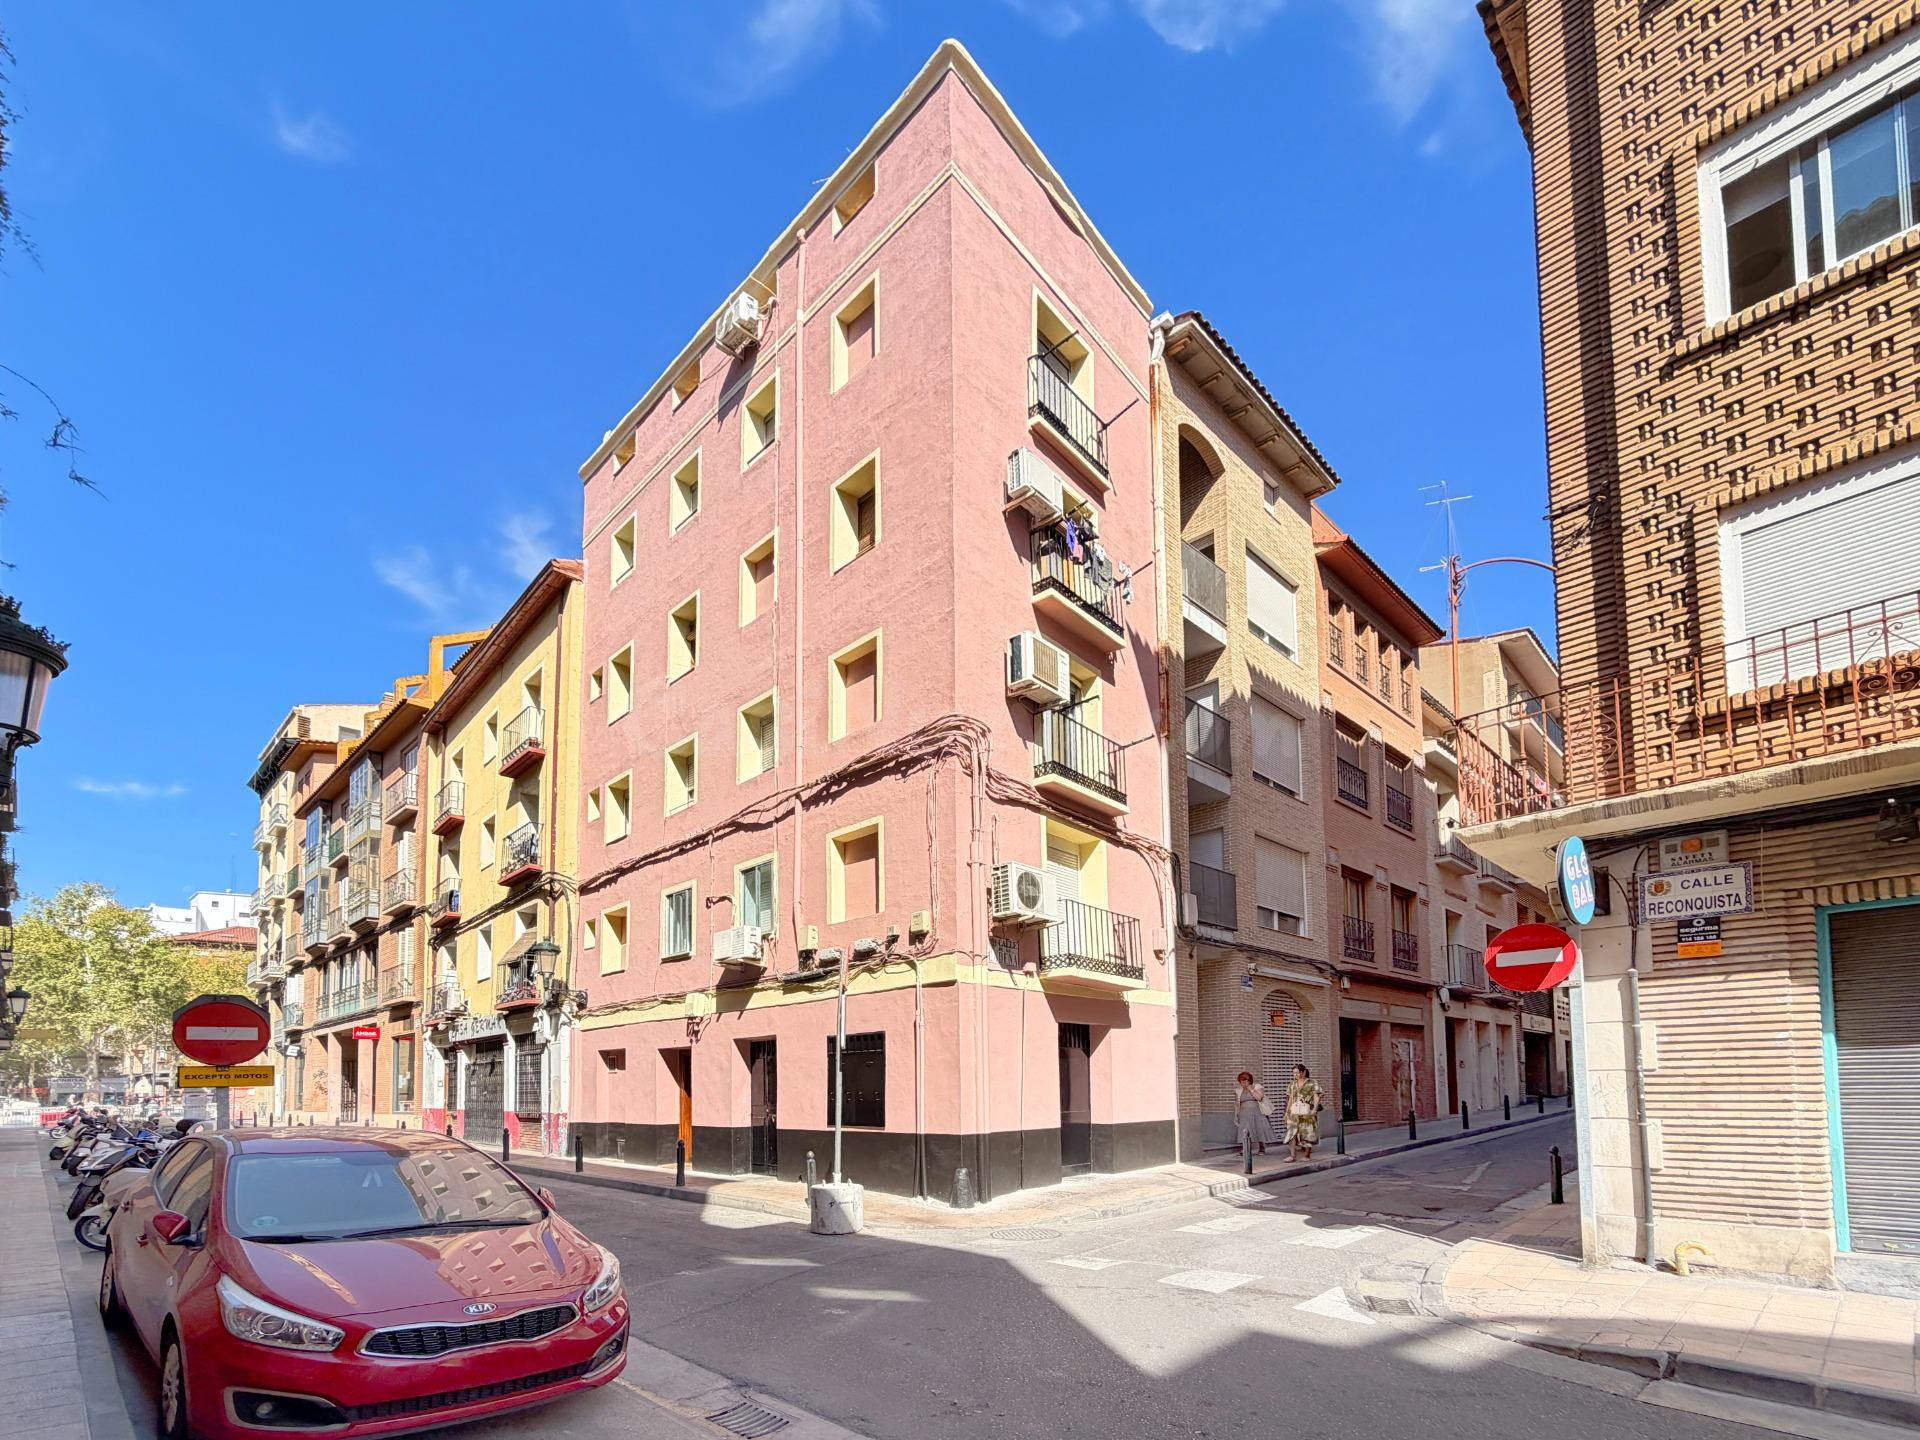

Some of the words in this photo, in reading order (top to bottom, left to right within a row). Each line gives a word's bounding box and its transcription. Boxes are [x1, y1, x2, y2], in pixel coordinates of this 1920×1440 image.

[1671, 852, 1712, 861] SAFETY
[1671, 856, 1714, 866] ALARMAS
[1680, 874, 1734, 889] CALLE
[1648, 893, 1742, 915] RECONQUISTA
[1679, 925, 1719, 933] segurma
[998, 939, 1018, 949] CALLE
[468, 1303, 493, 1313] KIA
